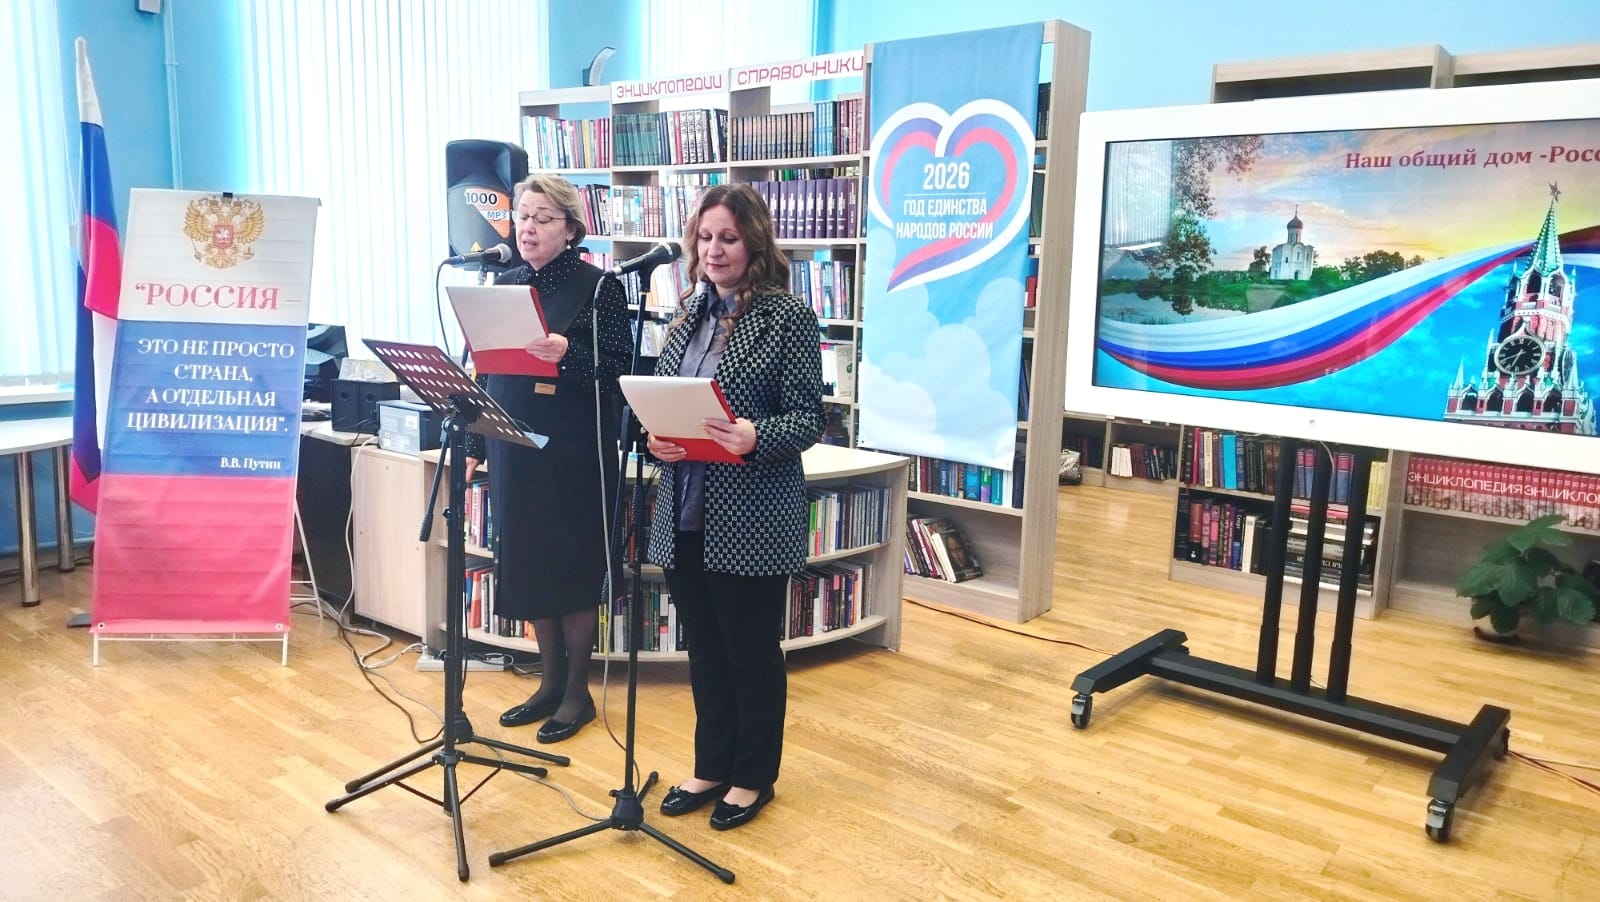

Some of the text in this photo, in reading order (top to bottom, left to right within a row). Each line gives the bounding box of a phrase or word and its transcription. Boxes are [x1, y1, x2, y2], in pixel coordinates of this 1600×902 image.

[738, 55, 864, 85] СПРАВОЧНИКИ
[616, 75, 722, 98] ЭНЦИКЛОПЕДИИ
[1345, 153, 1392, 169] Наш
[1399, 149, 1476, 169] общий
[1484, 150, 1531, 168] дом
[923, 162, 970, 190] 2026
[465, 192, 498, 205] 1000
[903, 198, 987, 218] ГОД ЕДИНСТВА
[487, 211, 507, 220] MP3
[896, 222, 994, 240] НАРОДОВ РОССИИ
[137, 338, 295, 359] ЭТО НЕ ПРОСТО
[174, 363, 253, 383] СТРАНА,
[146, 388, 276, 407] А ОТДЕЛЬНАЯ
[220, 457, 281, 471] В.В. Путин
[1408, 471, 1523, 495] ЭНЦИКЛОПЕДИЯ
